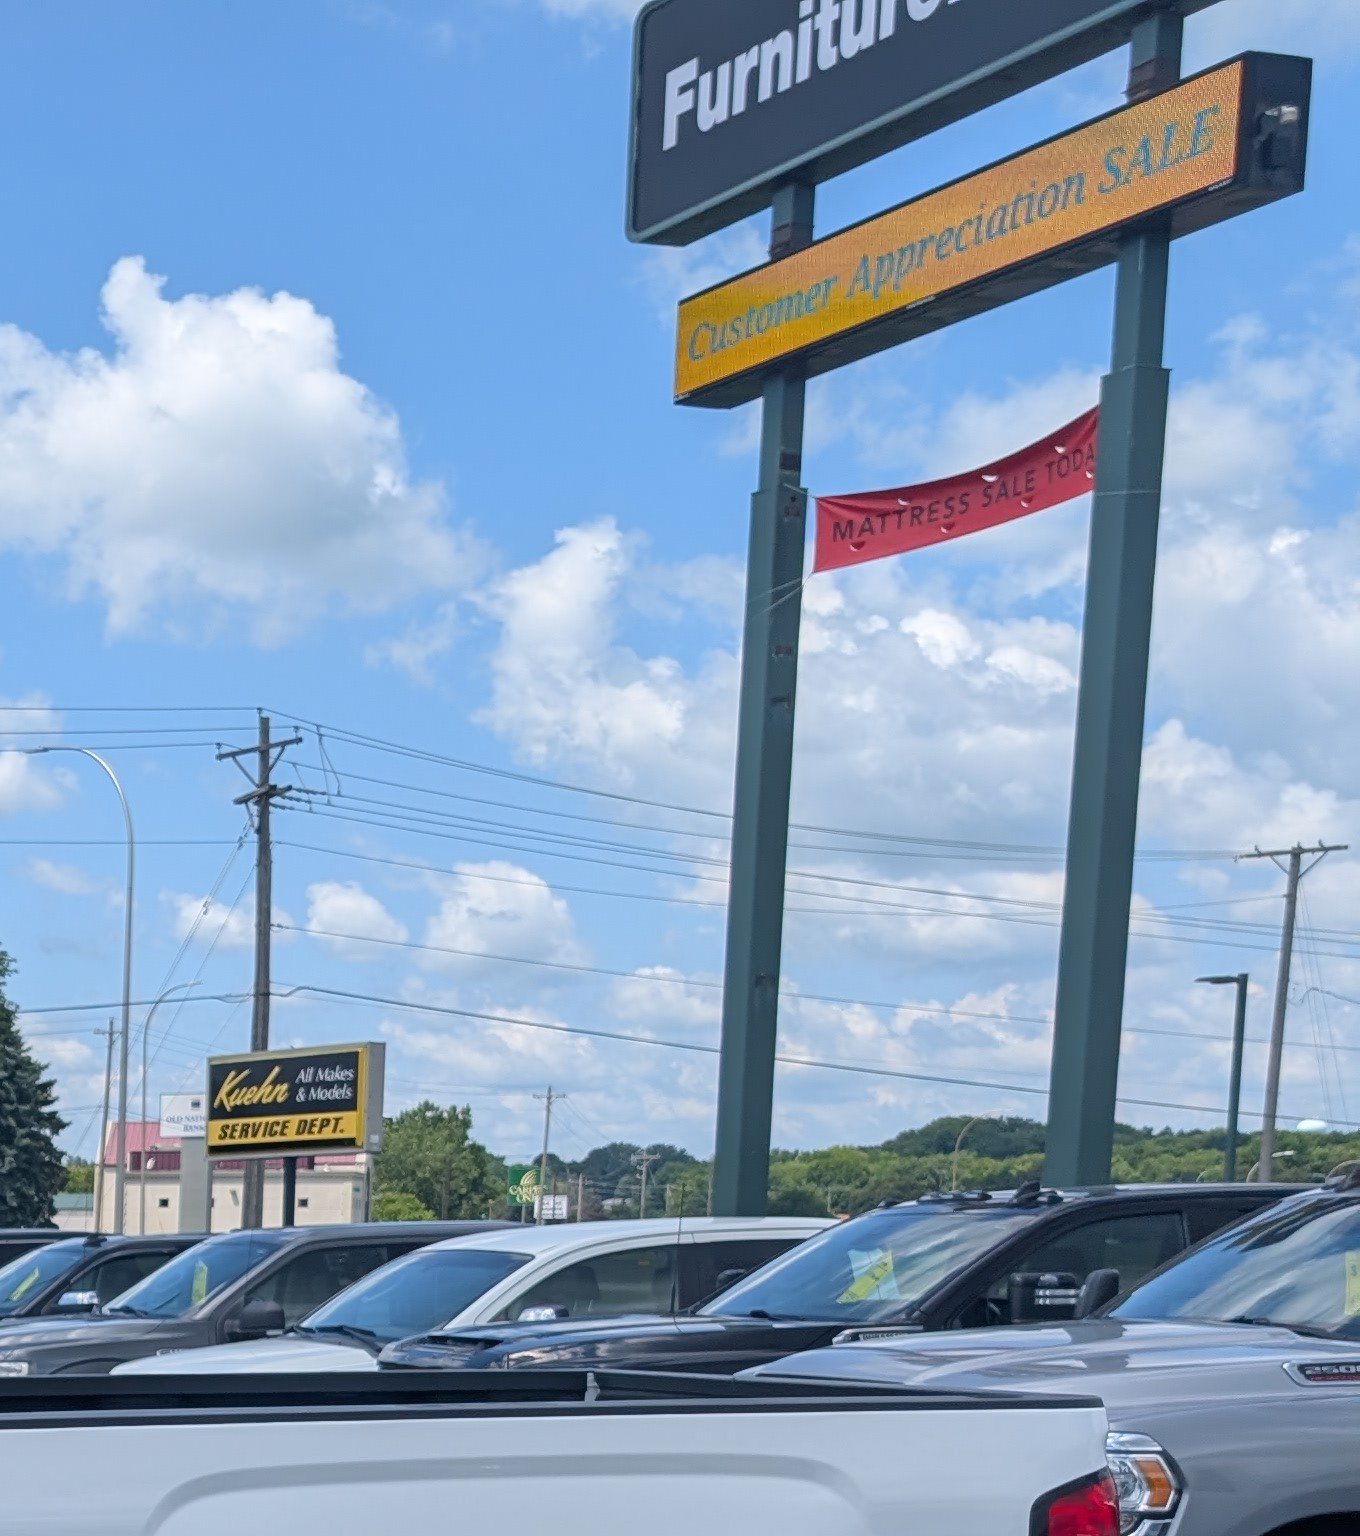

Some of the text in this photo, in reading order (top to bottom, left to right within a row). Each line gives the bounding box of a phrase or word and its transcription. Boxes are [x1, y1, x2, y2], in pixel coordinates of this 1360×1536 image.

[688, 103, 1221, 362] Customer Appreciation SALE
[832, 492, 970, 543] MATTRESS
[981, 469, 1036, 508] SALE
[294, 1064, 355, 1084] All Makes
[213, 1065, 291, 1113] Kuehn
[295, 1082, 354, 1103] & Models
[218, 1116, 345, 1141] SERVICE DEPT.
[1304, 1365, 1360, 1375] 250
